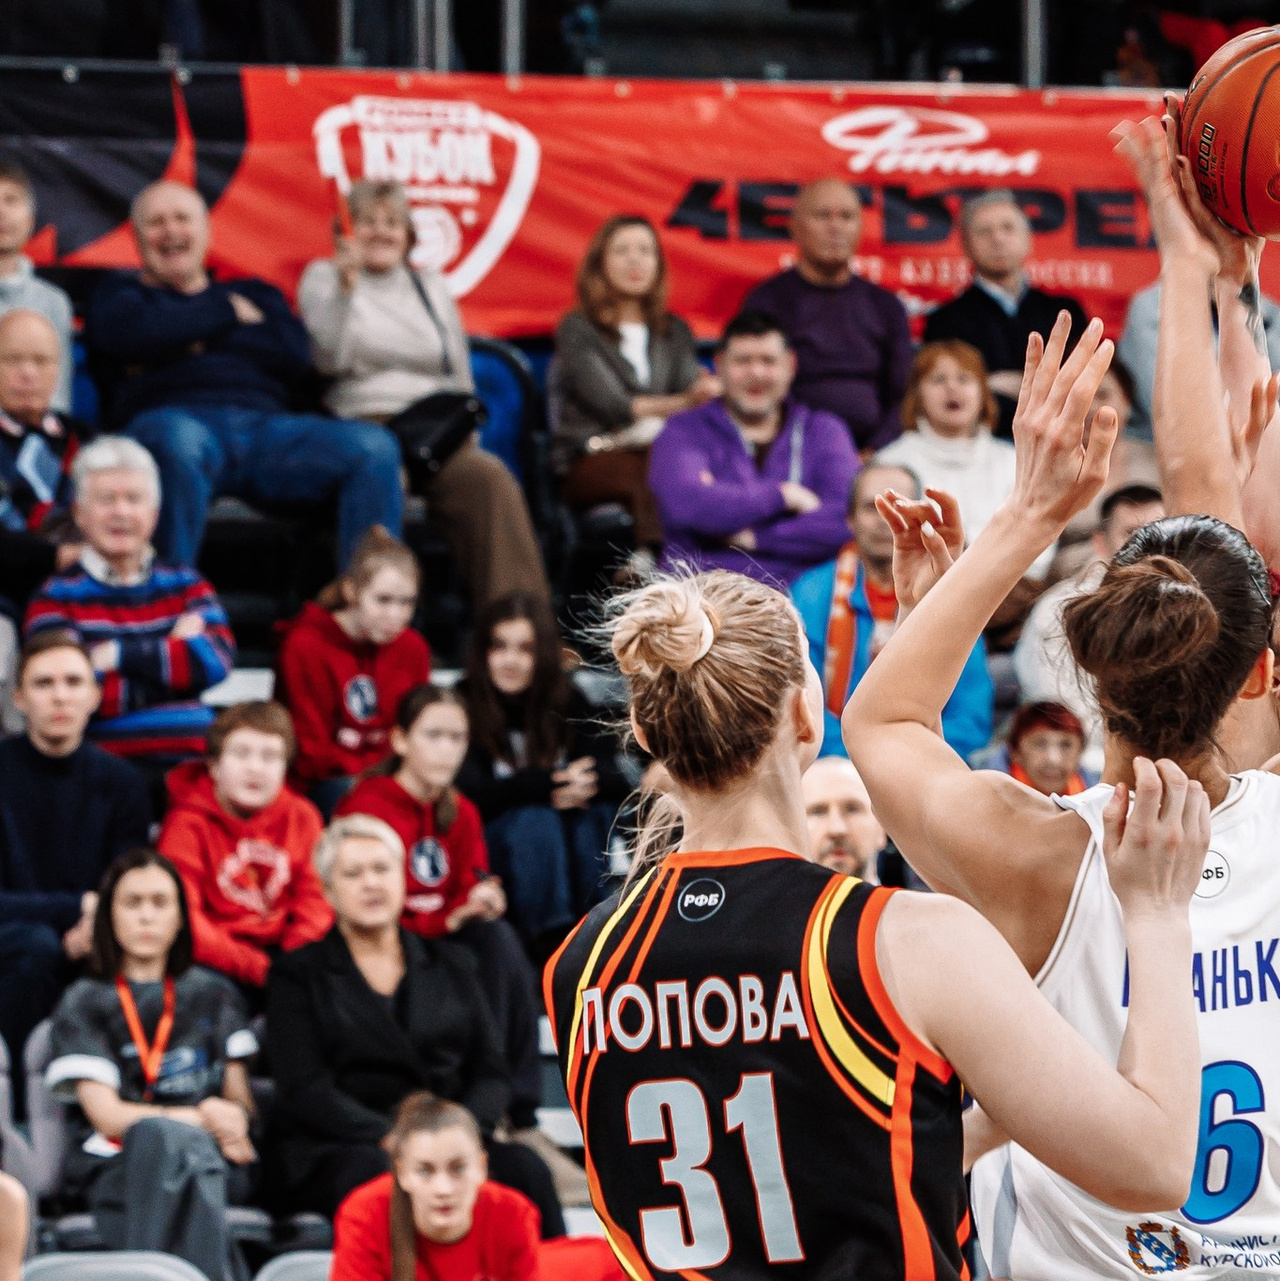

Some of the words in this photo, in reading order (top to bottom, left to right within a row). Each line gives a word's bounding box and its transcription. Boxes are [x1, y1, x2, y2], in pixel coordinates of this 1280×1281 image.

[362, 130, 497, 186] КУБОК
[683, 892, 720, 909] РФБ
[1201, 866, 1225, 881] ФБ
[582, 971, 809, 1054] ПОПОВА
[625, 1071, 805, 1272] 31
[1181, 1060, 1265, 1225] 6
